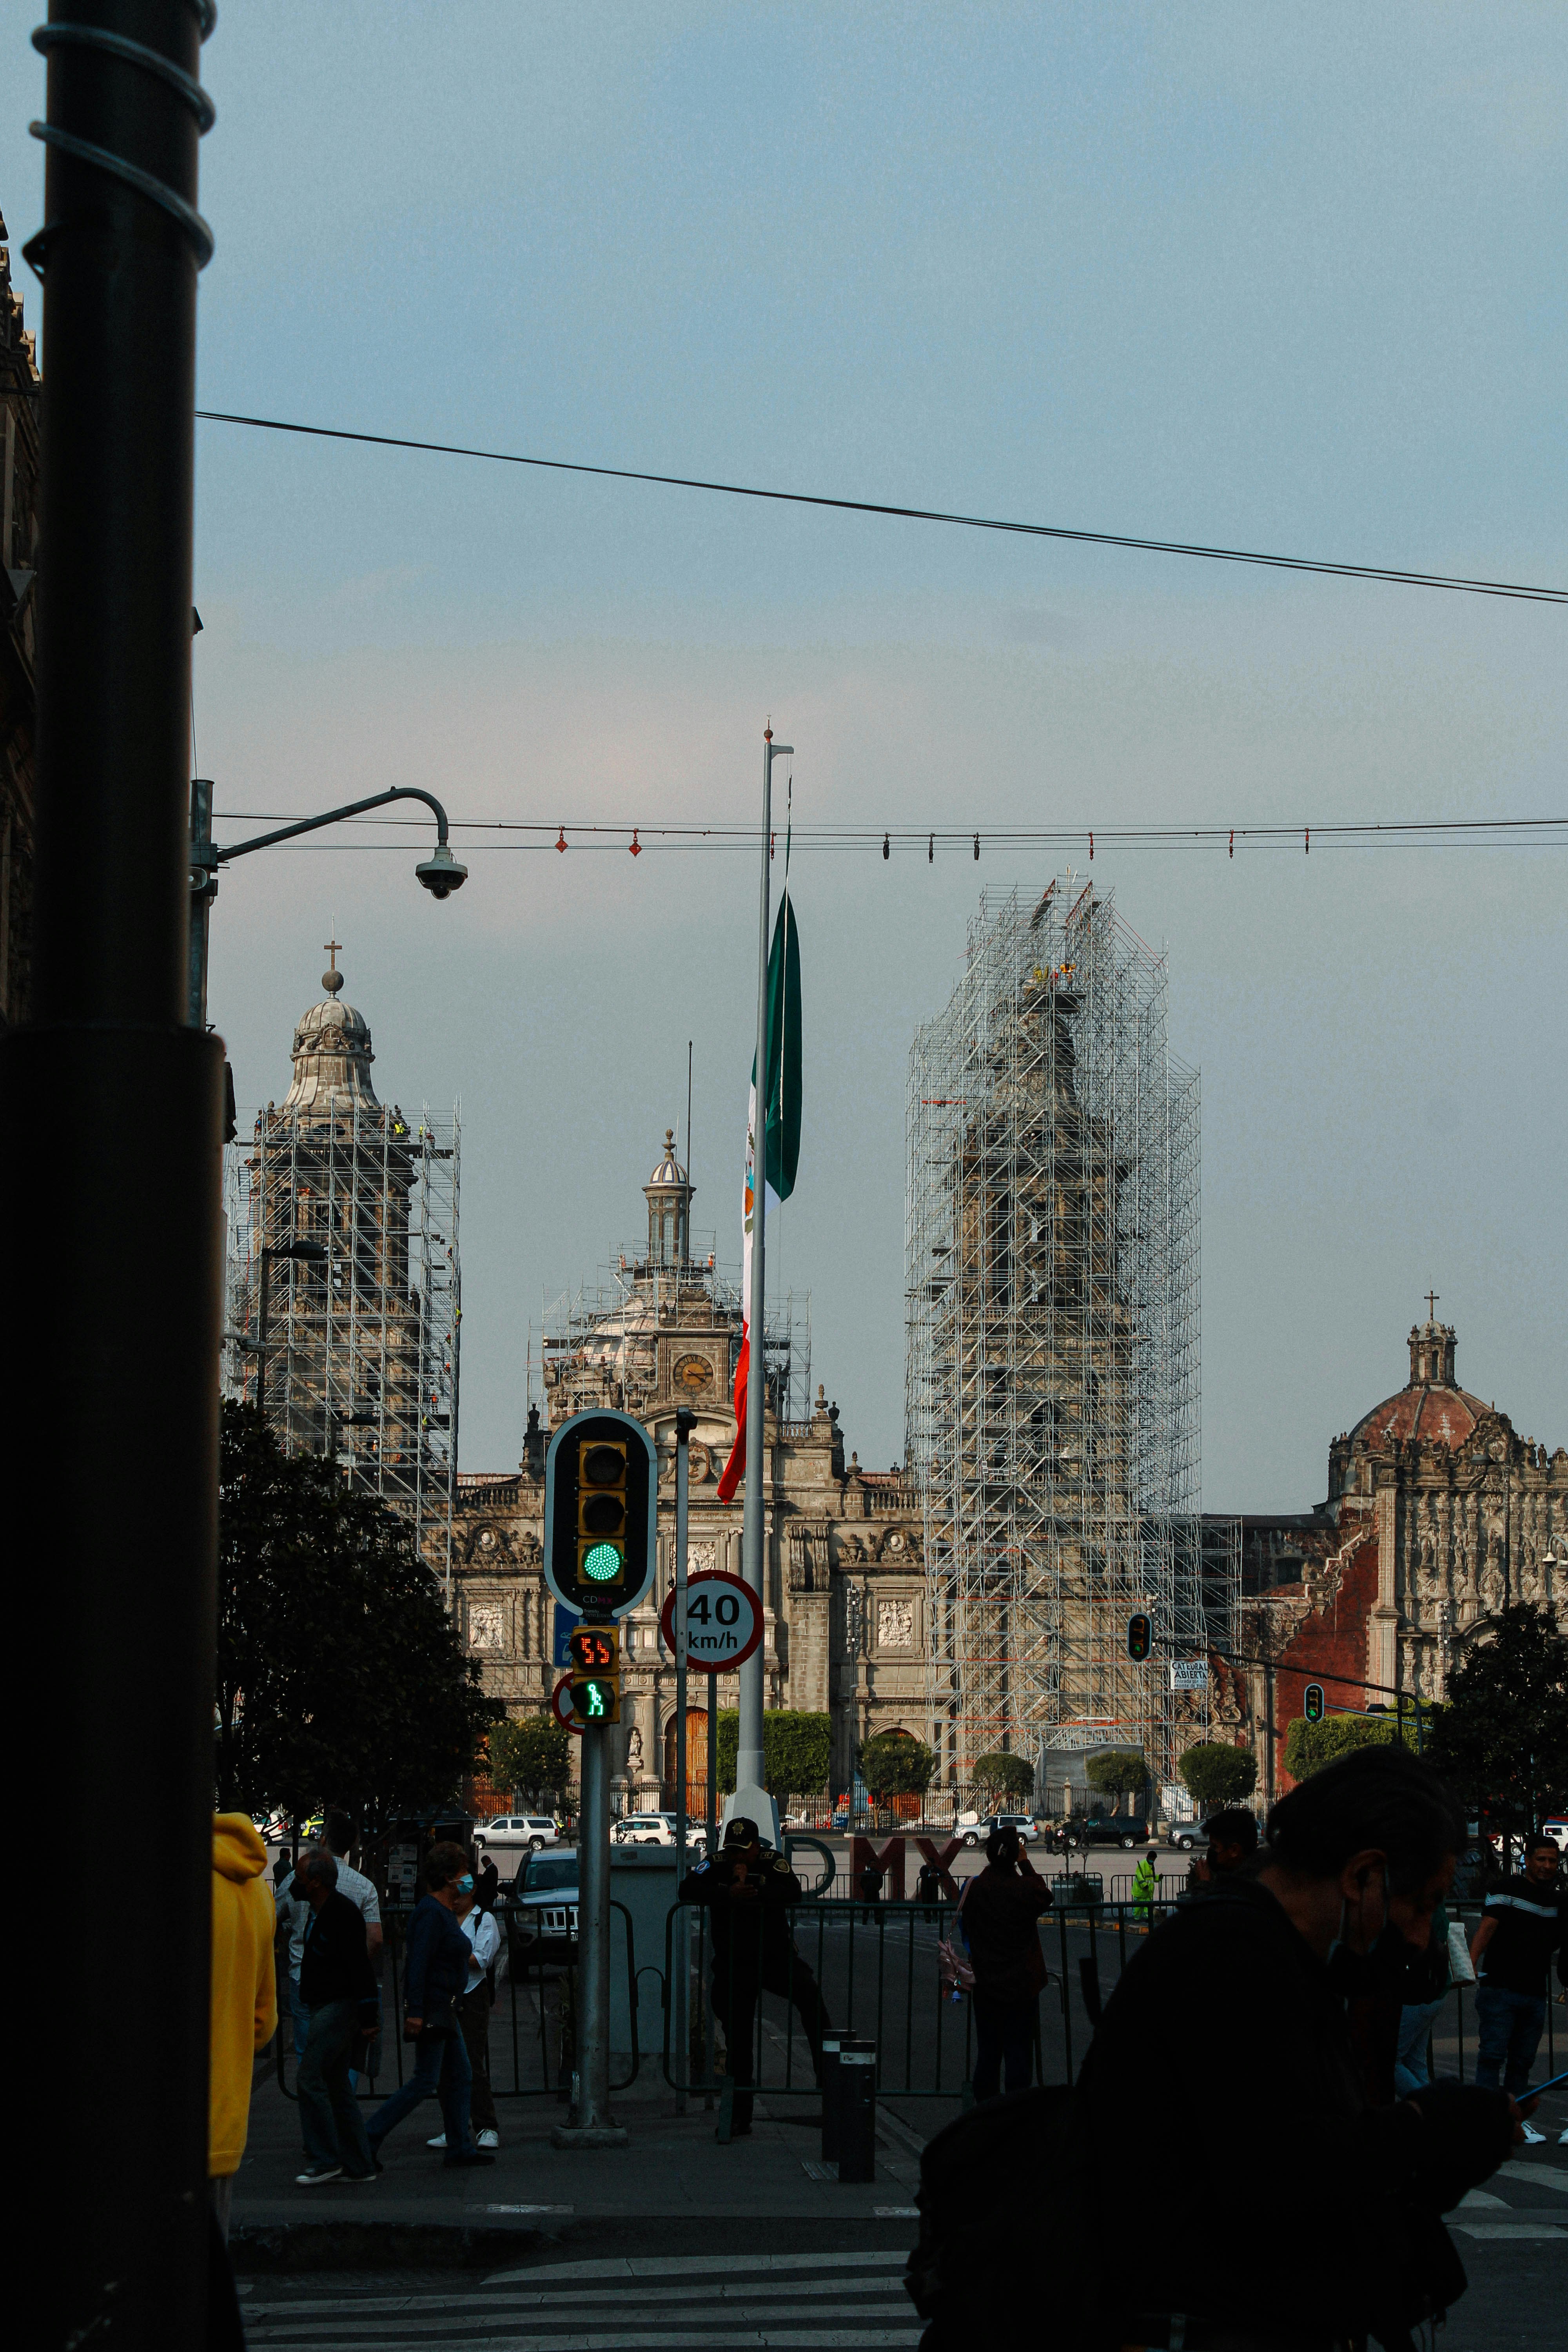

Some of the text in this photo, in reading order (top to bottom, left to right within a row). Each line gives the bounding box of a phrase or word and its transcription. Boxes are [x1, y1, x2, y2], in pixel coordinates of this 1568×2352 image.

[583, 1595, 613, 1604] CDMX
[687, 1595, 739, 1625] 40
[688, 1631, 737, 1648] km/h
[1172, 1662, 1207, 1671] CATEDRAL
[1174, 1670, 1207, 1679] ABIERTA
[759, 1836, 965, 1900] DMX
